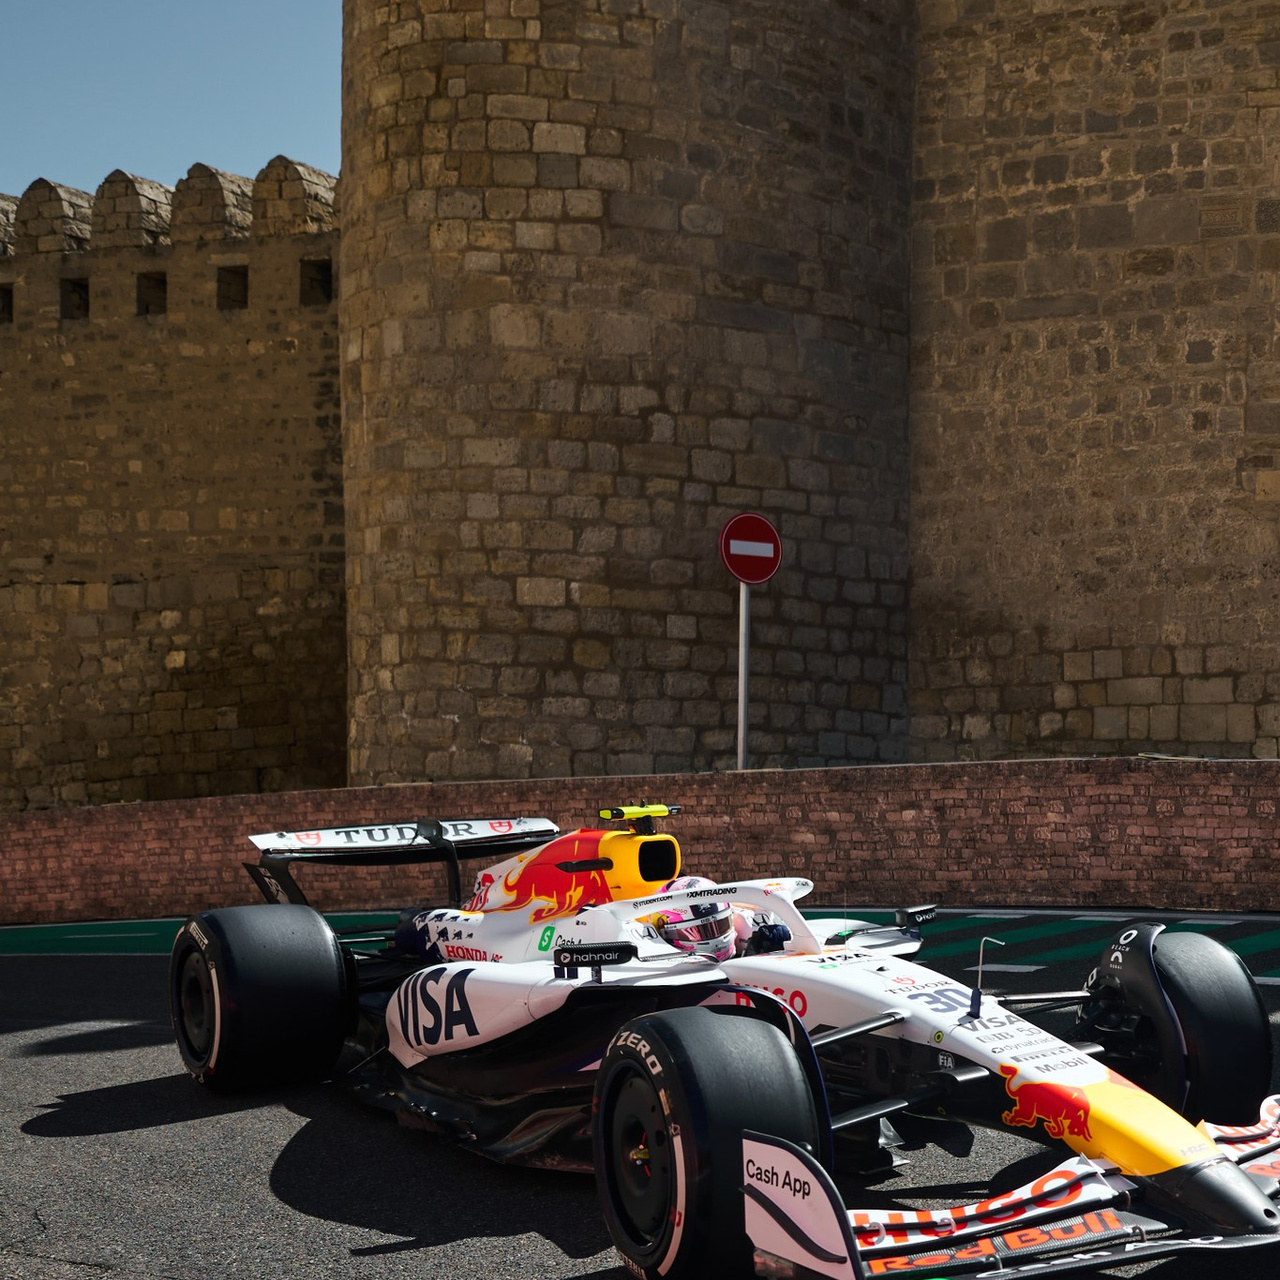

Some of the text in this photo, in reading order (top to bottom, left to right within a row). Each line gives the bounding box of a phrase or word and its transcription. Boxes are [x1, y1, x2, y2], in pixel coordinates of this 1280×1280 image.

[335, 822, 478, 844] TUDR
[445, 945, 488, 962] HONDA
[573, 951, 620, 962] hahnair
[884, 980, 953, 994] TUDOR
[397, 967, 480, 1049] VISA
[907, 988, 984, 1013] 30
[960, 1014, 1026, 1032] VISA
[616, 1031, 663, 1075] ZERO
[1034, 1057, 1089, 1074] Mobil
[746, 1159, 812, 1200] Cash App
[853, 1170, 1083, 1248] HUGO
[868, 1210, 1123, 1275] Red Bull
